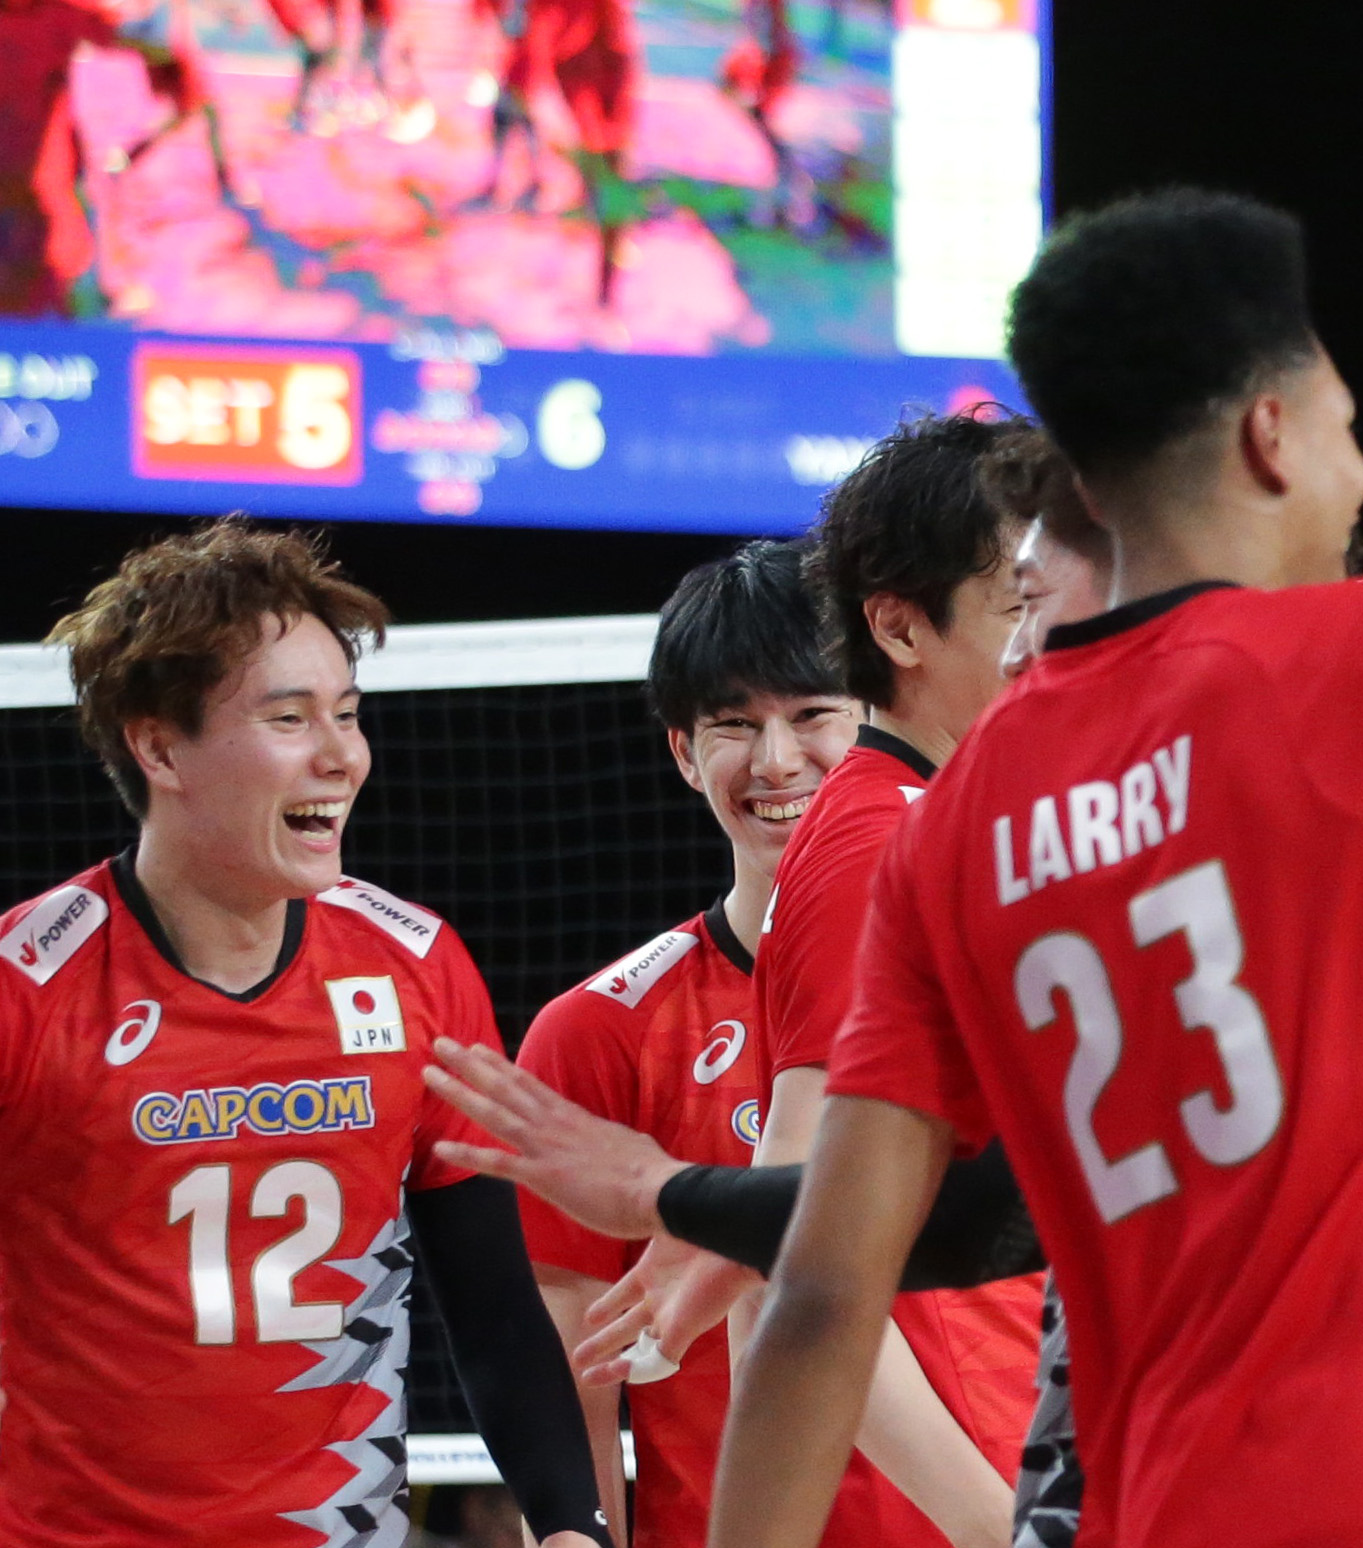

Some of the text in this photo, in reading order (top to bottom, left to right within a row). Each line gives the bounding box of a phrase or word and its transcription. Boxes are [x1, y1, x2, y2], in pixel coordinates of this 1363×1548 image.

[144, 373, 274, 446] SET
[276, 361, 353, 471] 5
[538, 377, 606, 471] 6
[992, 734, 1192, 908] LARRY
[38, 893, 92, 952] POWER
[355, 892, 431, 937] POWER
[629, 935, 679, 979] POWER
[352, 1027, 393, 1048] JPN
[1013, 857, 1285, 1226] 23
[132, 1075, 376, 1146] CAPCOM
[167, 1157, 347, 1347] 12
